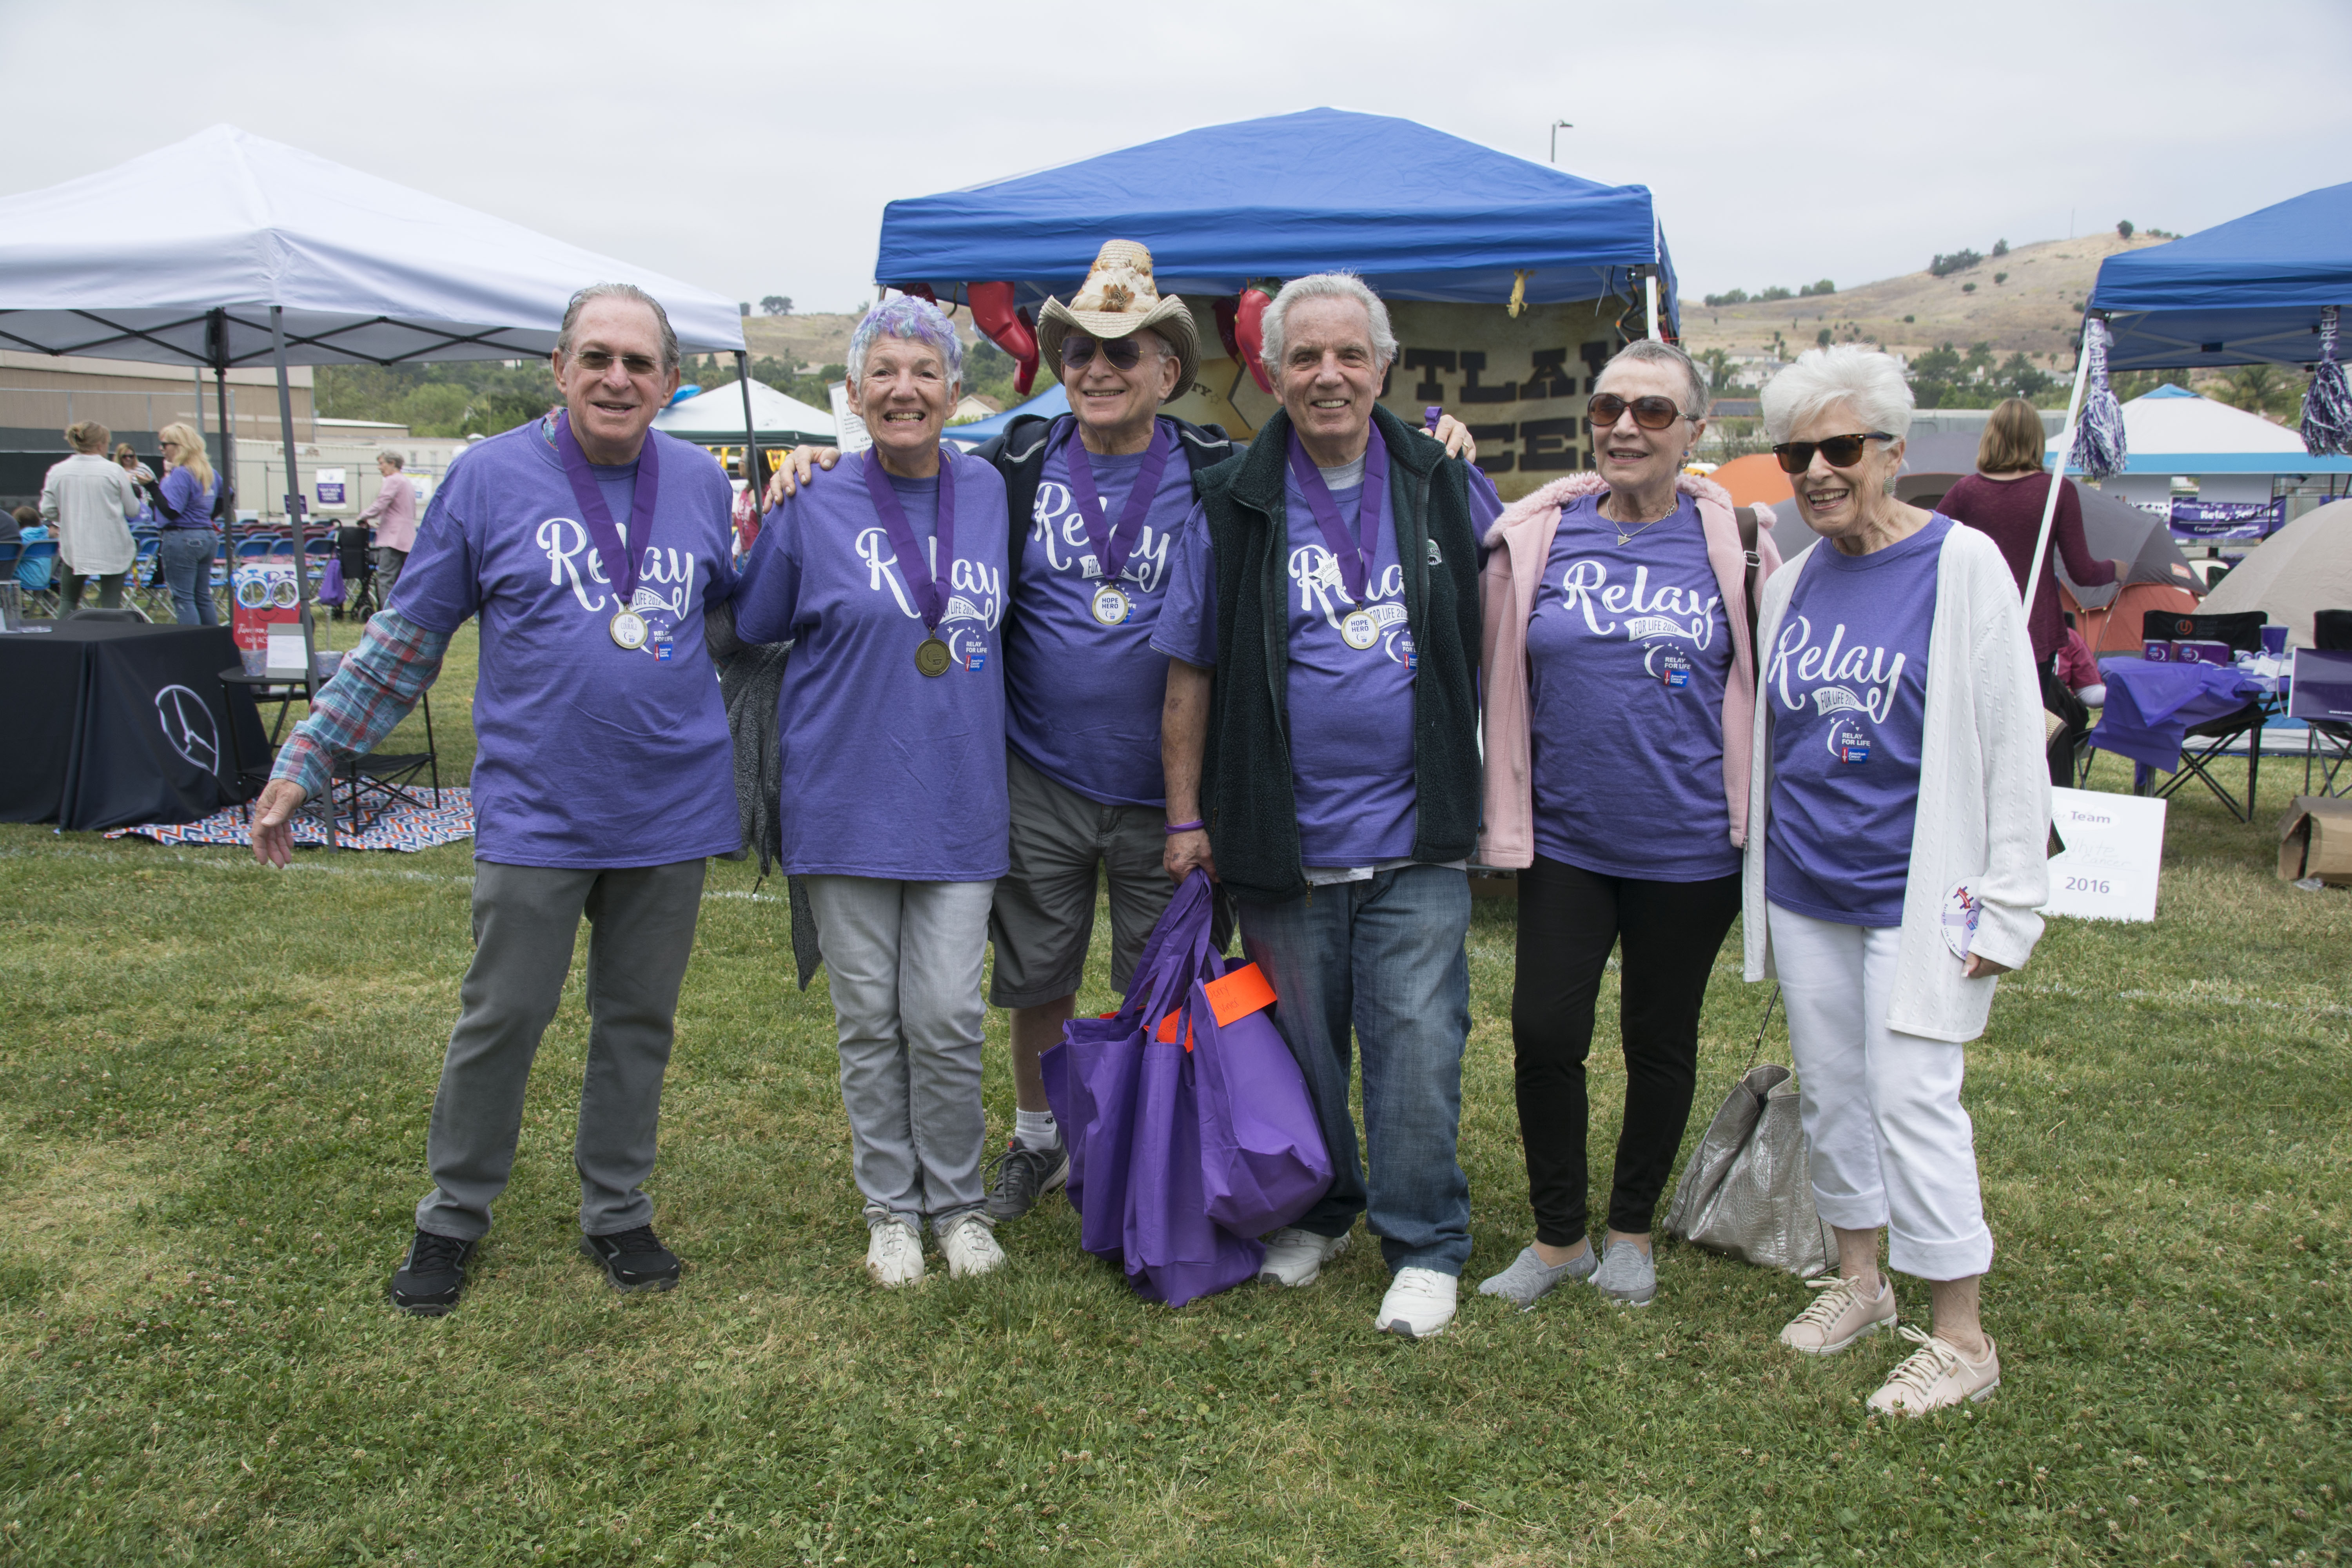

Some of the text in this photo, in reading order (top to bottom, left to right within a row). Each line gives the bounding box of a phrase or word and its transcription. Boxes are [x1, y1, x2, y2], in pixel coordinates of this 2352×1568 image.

[1318, 562, 1336, 577] SHERIFF
[648, 595, 661, 606] 2018
[950, 600, 962, 615] LIFE
[963, 604, 975, 615] 2018
[1563, 561, 1718, 651] Relay
[1382, 608, 1395, 620] LIFE
[1635, 619, 1677, 636] FOR LIFE 2018
[1768, 615, 1906, 724] Relay
[1820, 690, 1856, 711] FOR LIFE 2018
[2071, 811, 2111, 824] Team
[2082, 853, 2132, 867] Cancer
[2065, 876, 2110, 894] 2016
[1205, 984, 1230, 1000] Jerry
